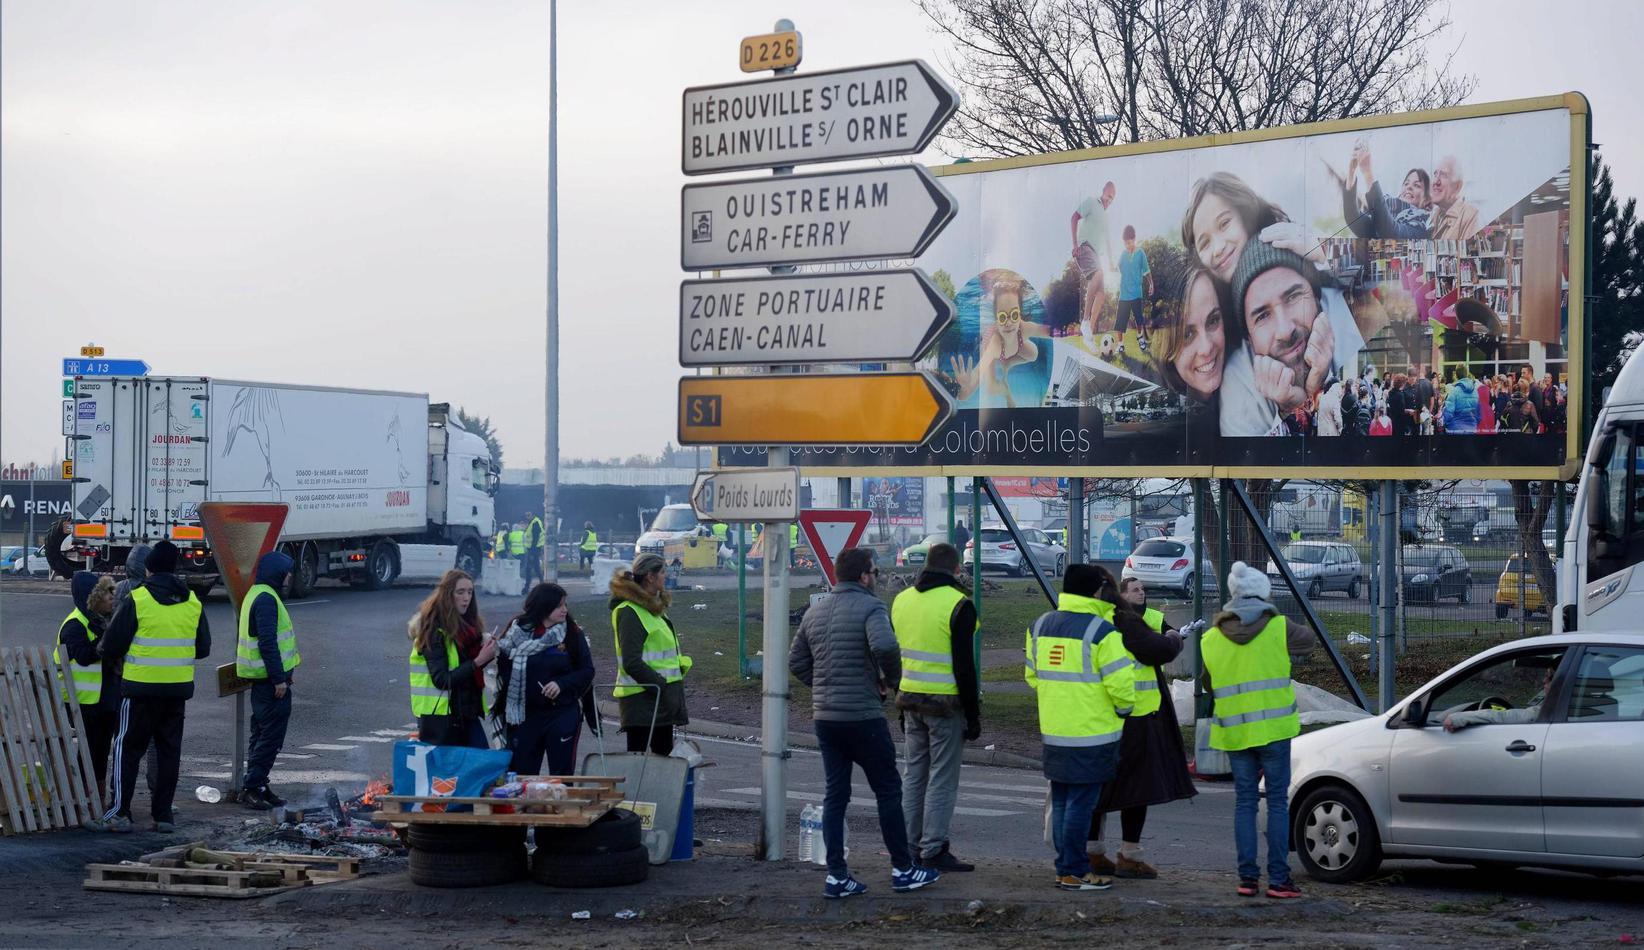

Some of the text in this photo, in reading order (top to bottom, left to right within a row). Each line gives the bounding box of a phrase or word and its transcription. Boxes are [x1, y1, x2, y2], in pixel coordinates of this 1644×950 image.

[743, 39, 794, 64] D 226
[692, 89, 814, 126] HÉROUVILLE
[847, 77, 908, 108] CLAIR
[692, 123, 813, 159] BLAINVILLE
[847, 112, 908, 142] ORNE
[726, 182, 889, 220] OUISTREHAM
[726, 220, 851, 254] CAR-FERRY
[690, 286, 886, 319] ZONE PORTUAIRE
[690, 323, 827, 352] CAEN-CANAL
[98, 363, 110, 373] 13
[152, 434, 191, 444] JOURDAN
[24, 500, 72, 515] RENA
[717, 484, 749, 508] Poids
[753, 483, 793, 508] Lourds
[150, 509, 159, 518] 80
[171, 509, 179, 518] 90
